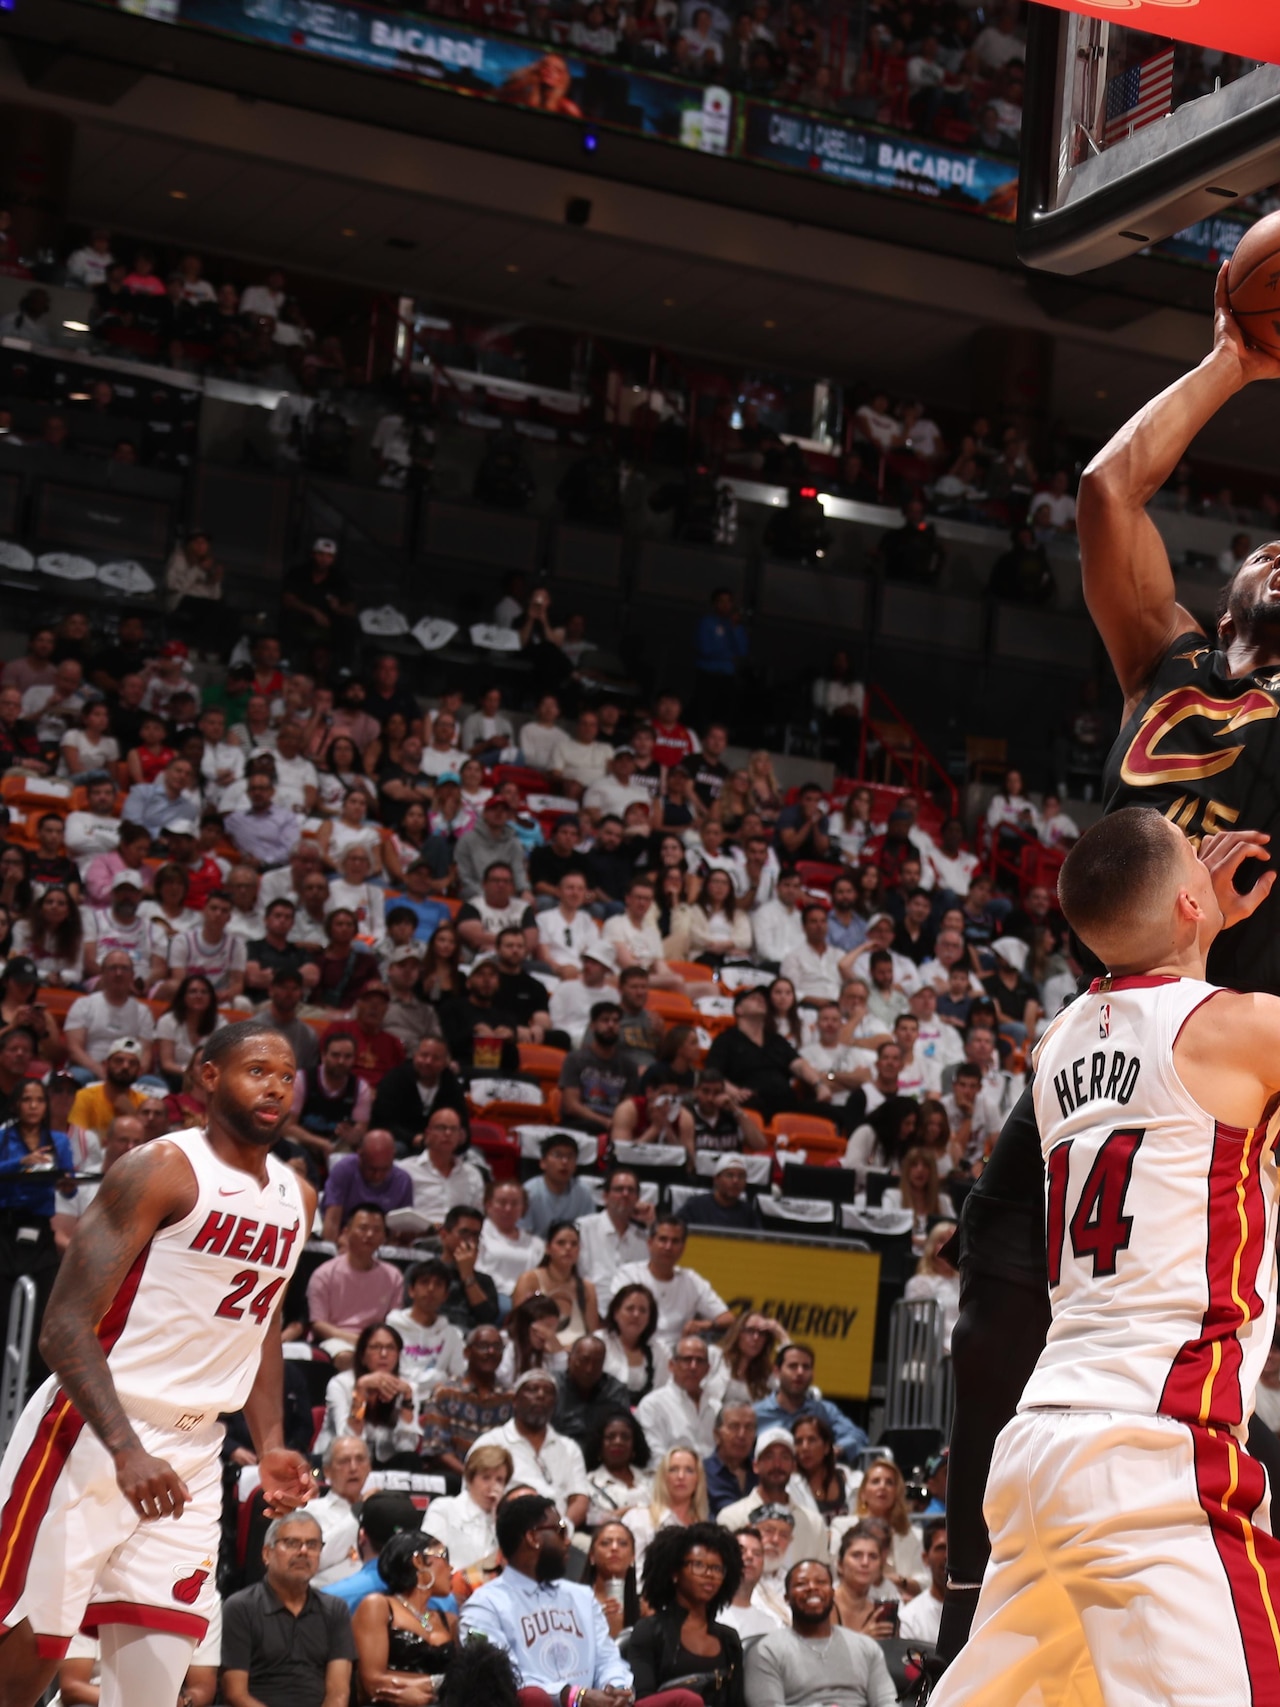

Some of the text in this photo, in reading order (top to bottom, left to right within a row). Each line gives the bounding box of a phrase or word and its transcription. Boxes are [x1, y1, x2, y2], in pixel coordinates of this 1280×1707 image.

[371, 20, 485, 70] BACARDÍ
[878, 142, 977, 188] BACARDÍ
[1053, 1051, 1141, 1119] HERRO
[1046, 1128, 1147, 1291] 14
[188, 1210, 300, 1269] HEAT
[214, 1268, 286, 1325] 24
[520, 1609, 584, 1649] GUCCI
